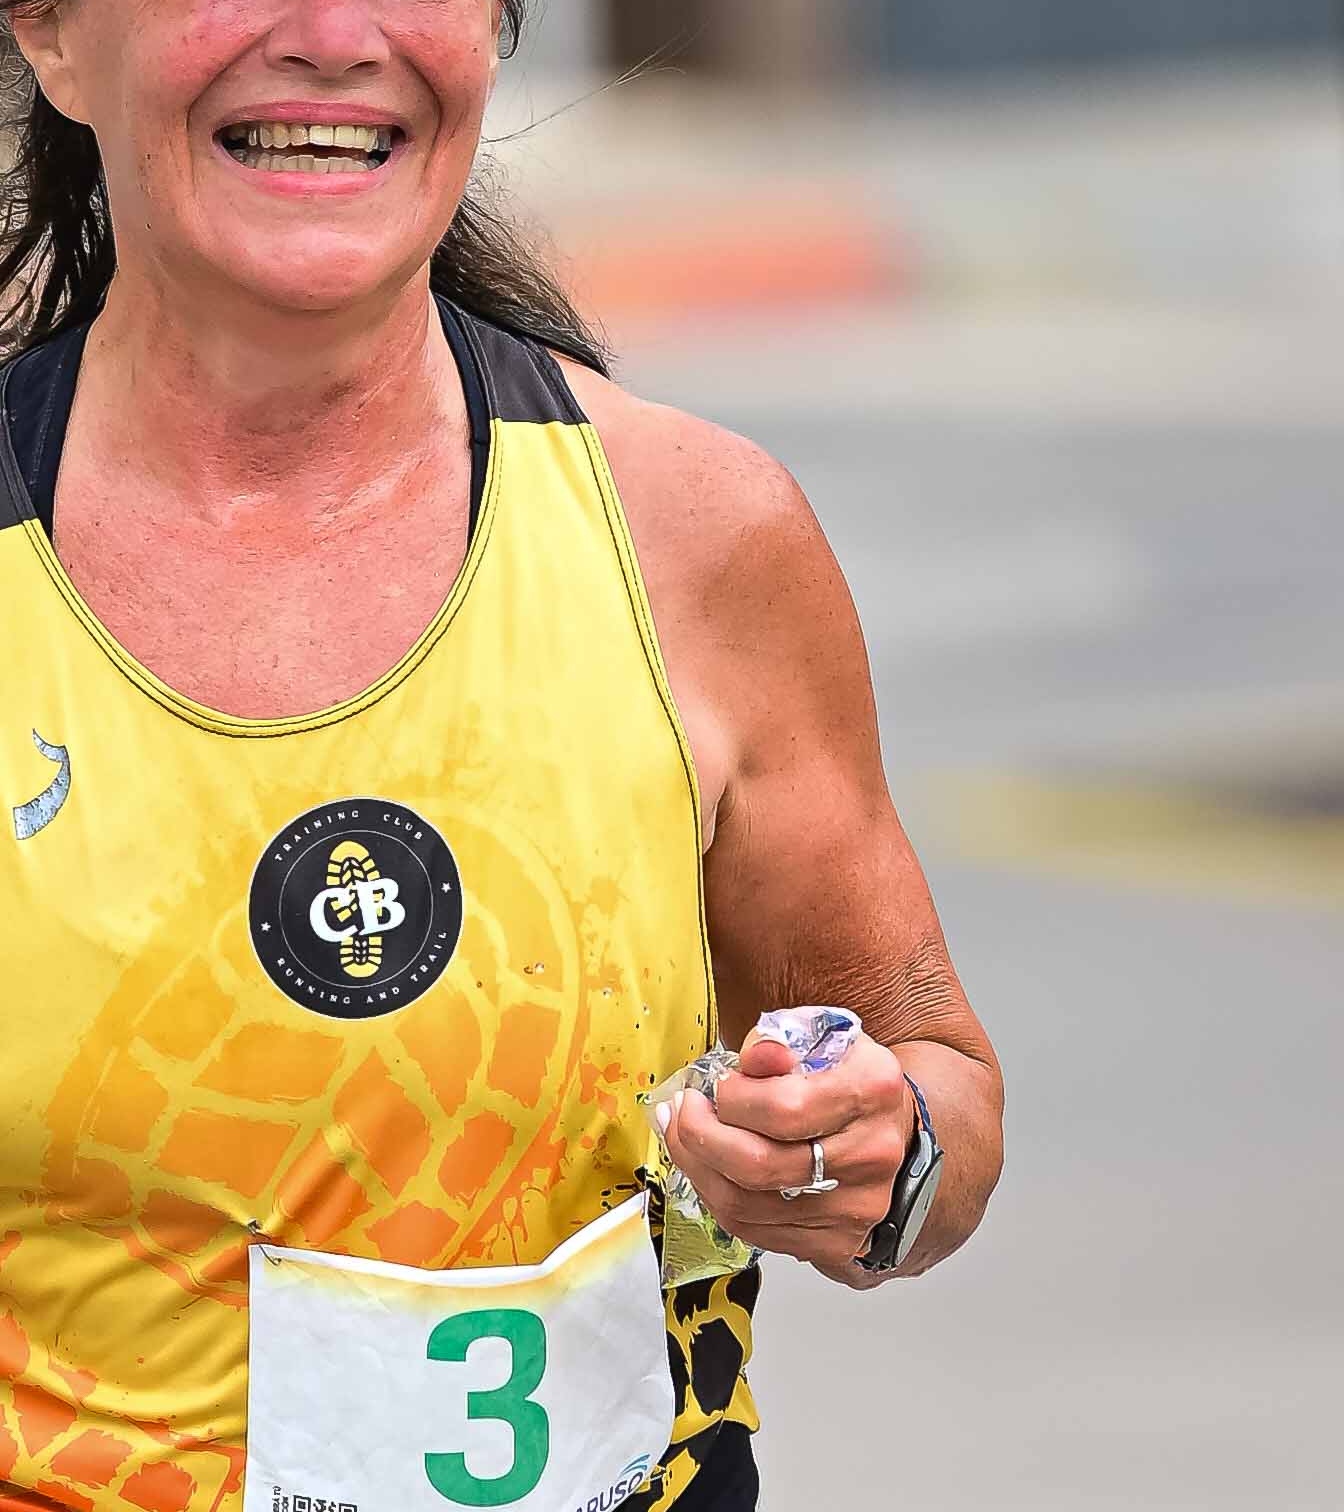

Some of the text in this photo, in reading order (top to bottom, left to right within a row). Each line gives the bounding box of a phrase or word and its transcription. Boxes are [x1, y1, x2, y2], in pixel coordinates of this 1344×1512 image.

[275, 810, 423, 863] TRAINING CLUB
[277, 931, 448, 1005] RUNNING AND TRAIL
[424, 1308, 550, 1507] 3
